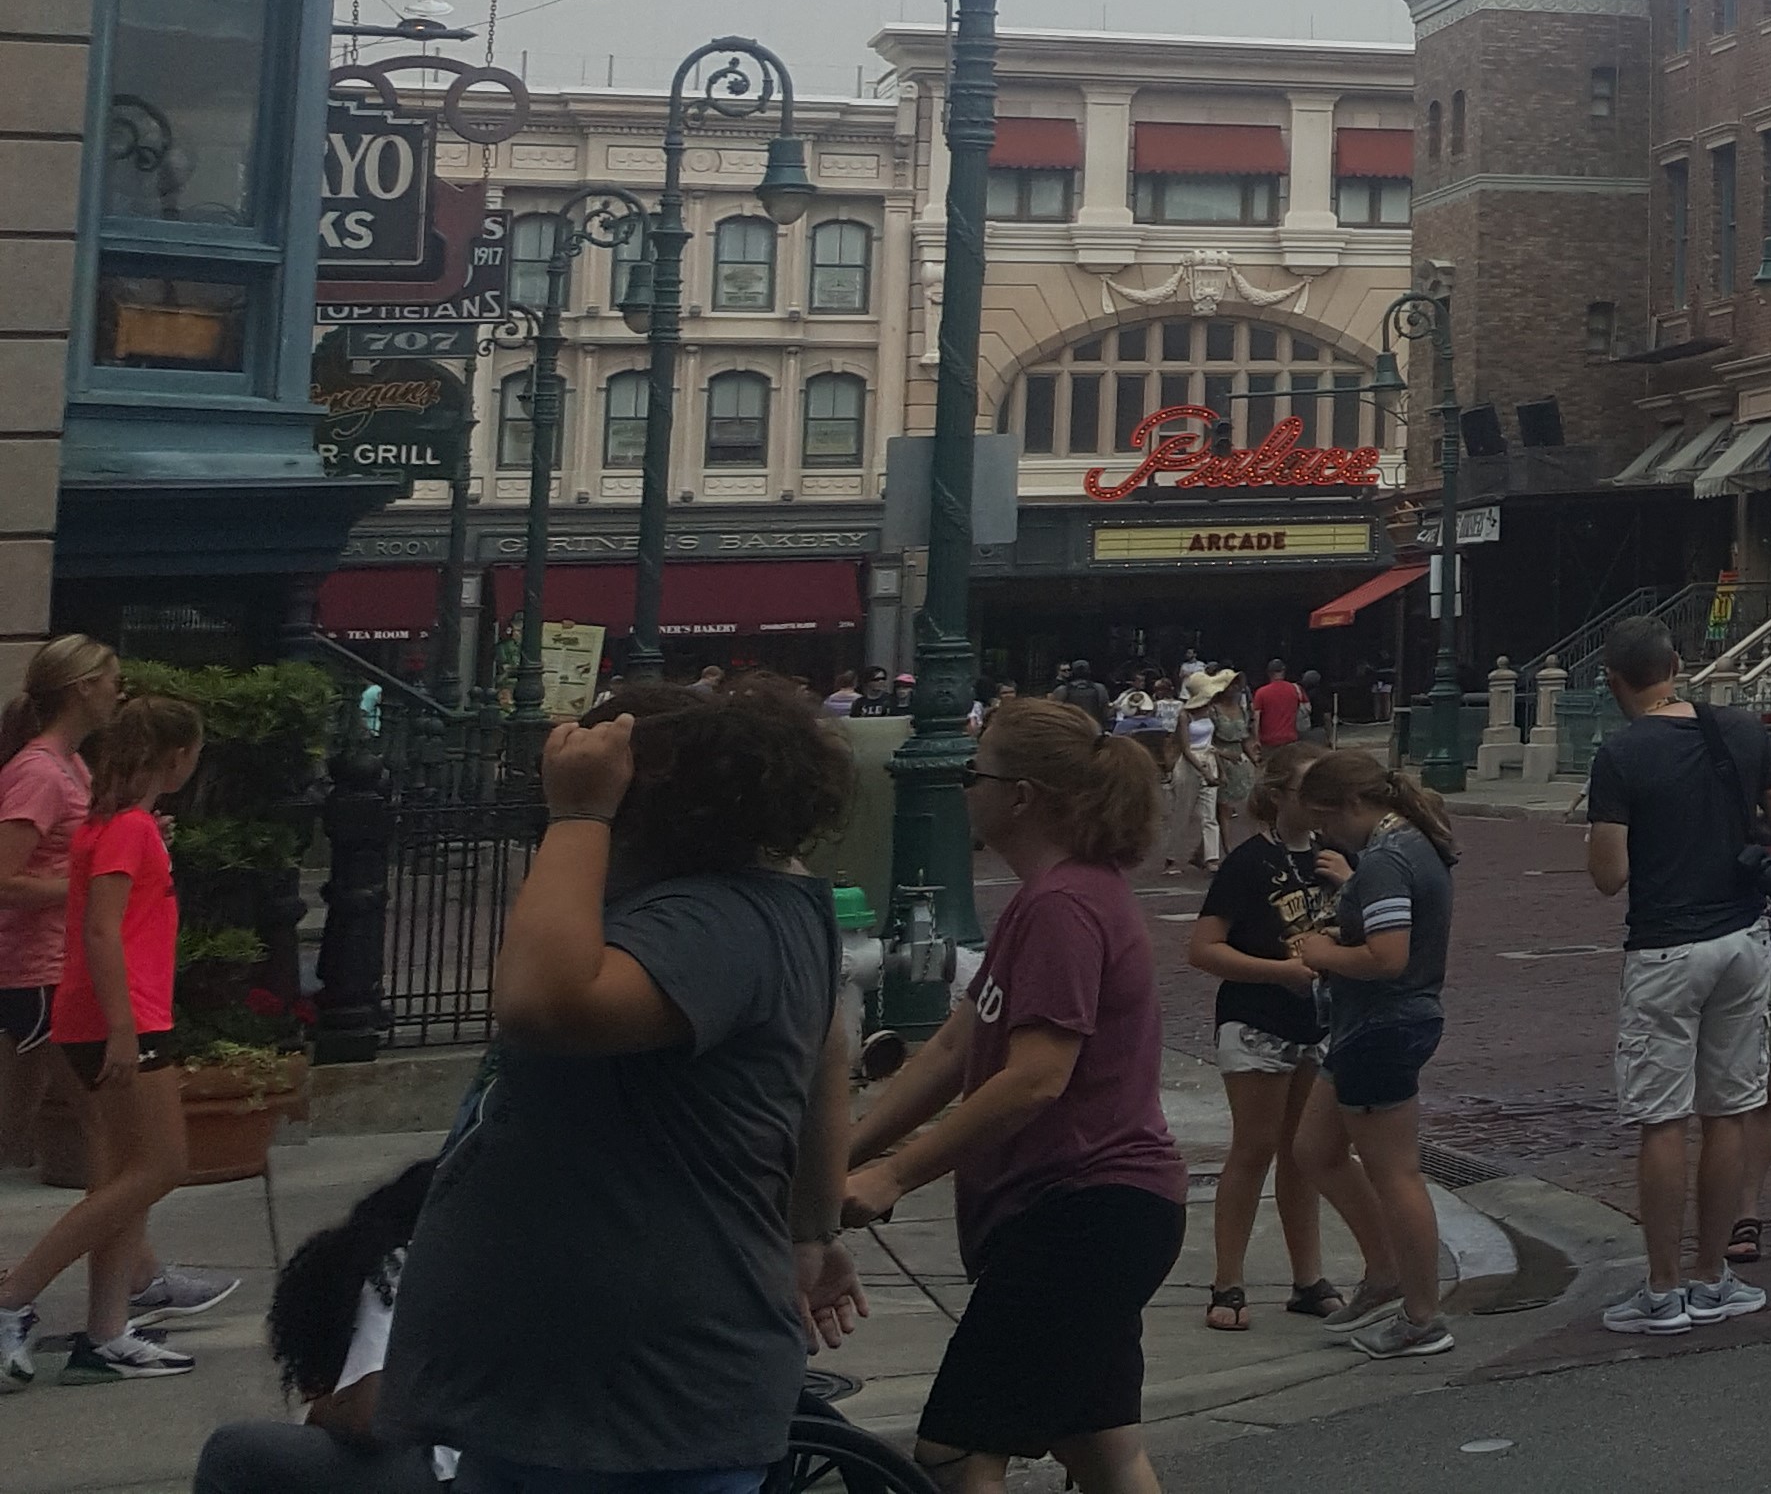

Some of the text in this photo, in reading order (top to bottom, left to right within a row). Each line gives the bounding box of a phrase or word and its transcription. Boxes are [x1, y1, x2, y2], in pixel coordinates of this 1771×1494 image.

[322, 133, 414, 200] YO
[474, 246, 504, 266] 1917
[363, 331, 458, 350] 707
[1084, 404, 1380, 502] Palace
[718, 532, 868, 550] BAKERY
[1188, 531, 1287, 552] ARCADE
[348, 630, 410, 639] TEA ROOM
[693, 623, 738, 634] BAKERY
